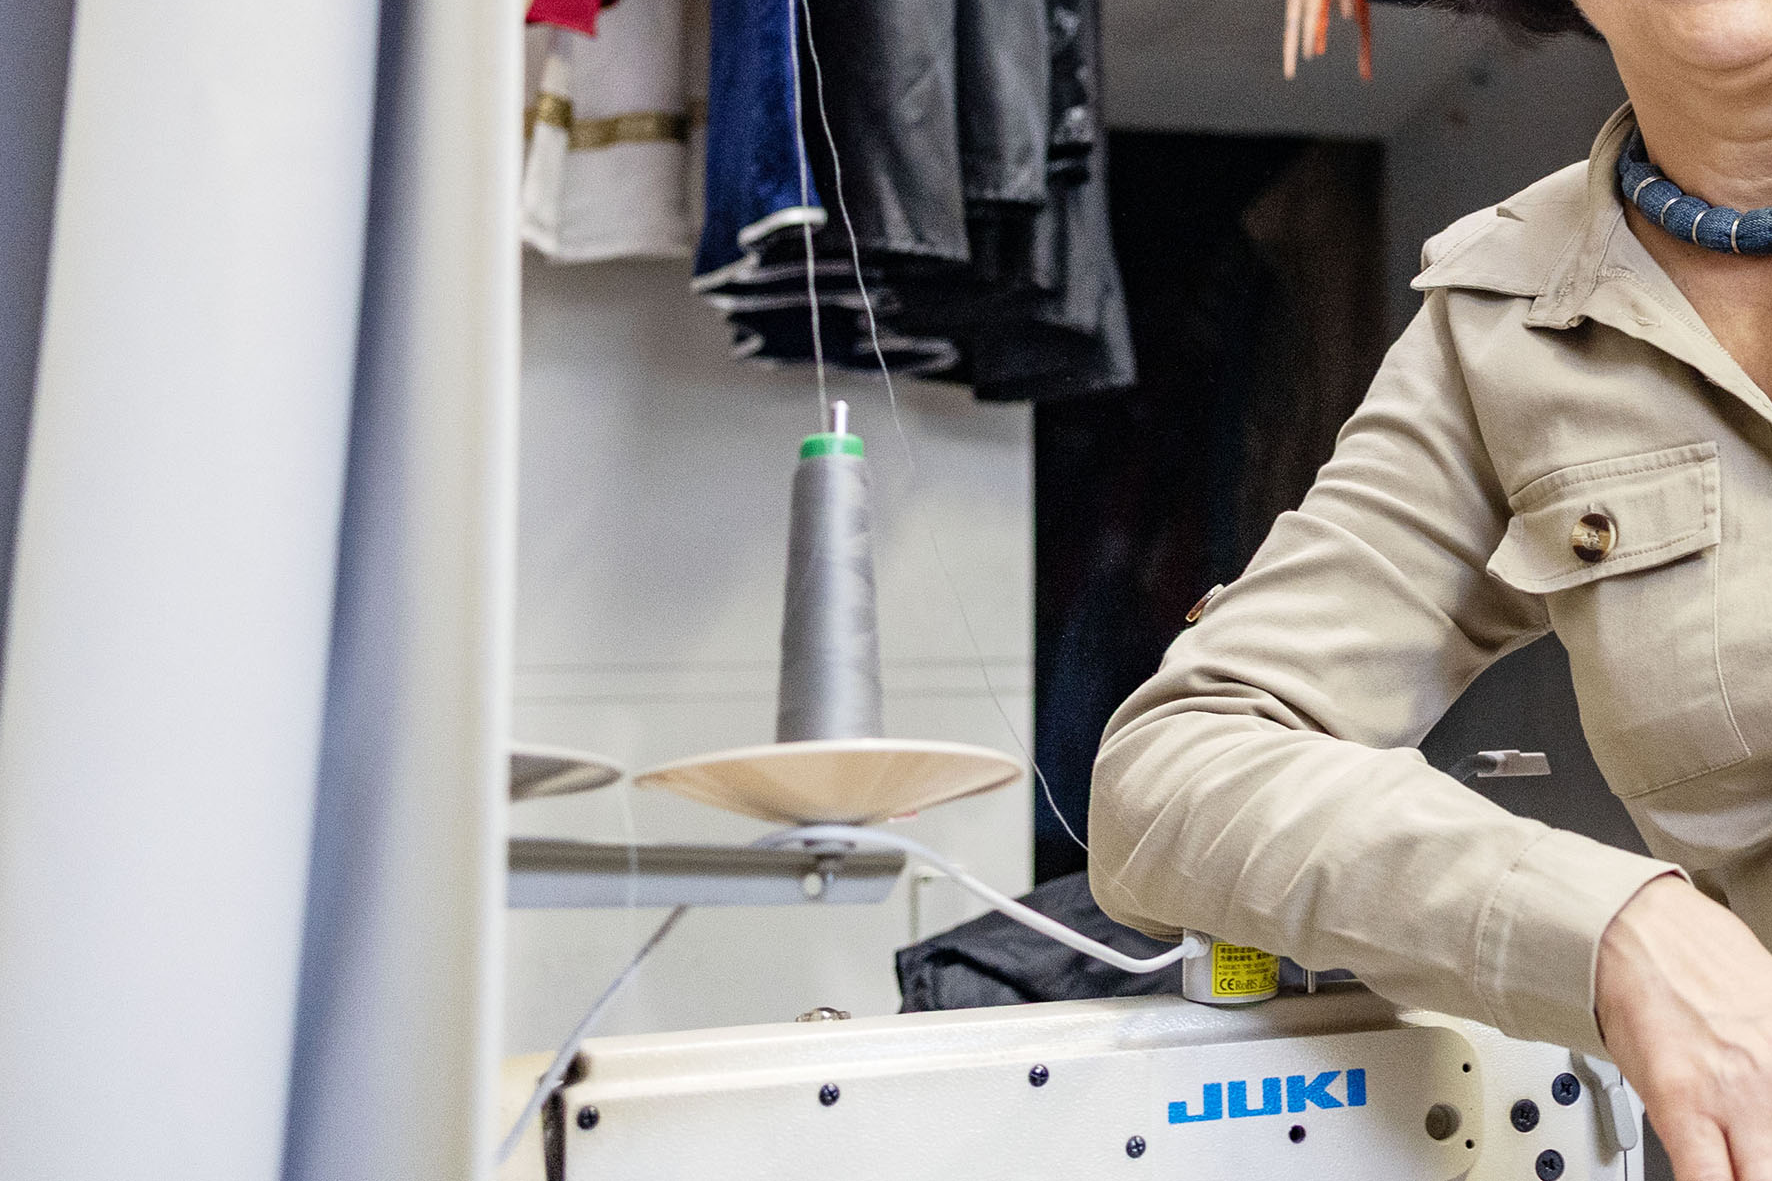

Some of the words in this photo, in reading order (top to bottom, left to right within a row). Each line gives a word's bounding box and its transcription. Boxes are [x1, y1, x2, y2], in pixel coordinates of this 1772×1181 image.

[1219, 978, 1235, 991] CE
[1235, 979, 1259, 990] RoHS
[1167, 1068, 1367, 1125] JUKI
